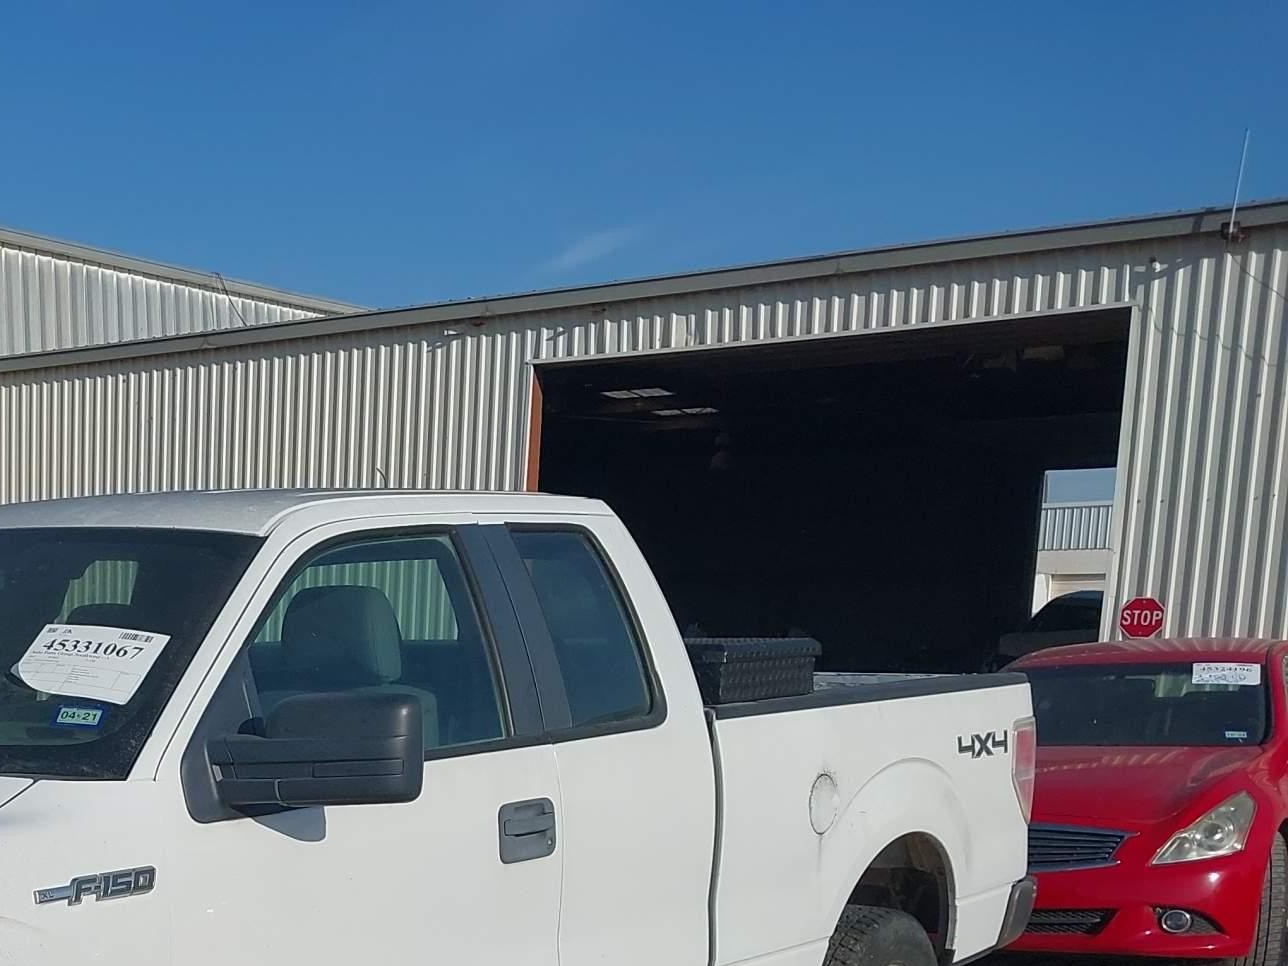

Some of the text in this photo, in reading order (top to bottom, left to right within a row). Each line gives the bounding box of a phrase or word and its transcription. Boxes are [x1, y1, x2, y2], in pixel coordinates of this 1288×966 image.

[1121, 610, 1162, 626] STOP
[43, 638, 144, 660] 45331067
[68, 865, 156, 906] F-150
